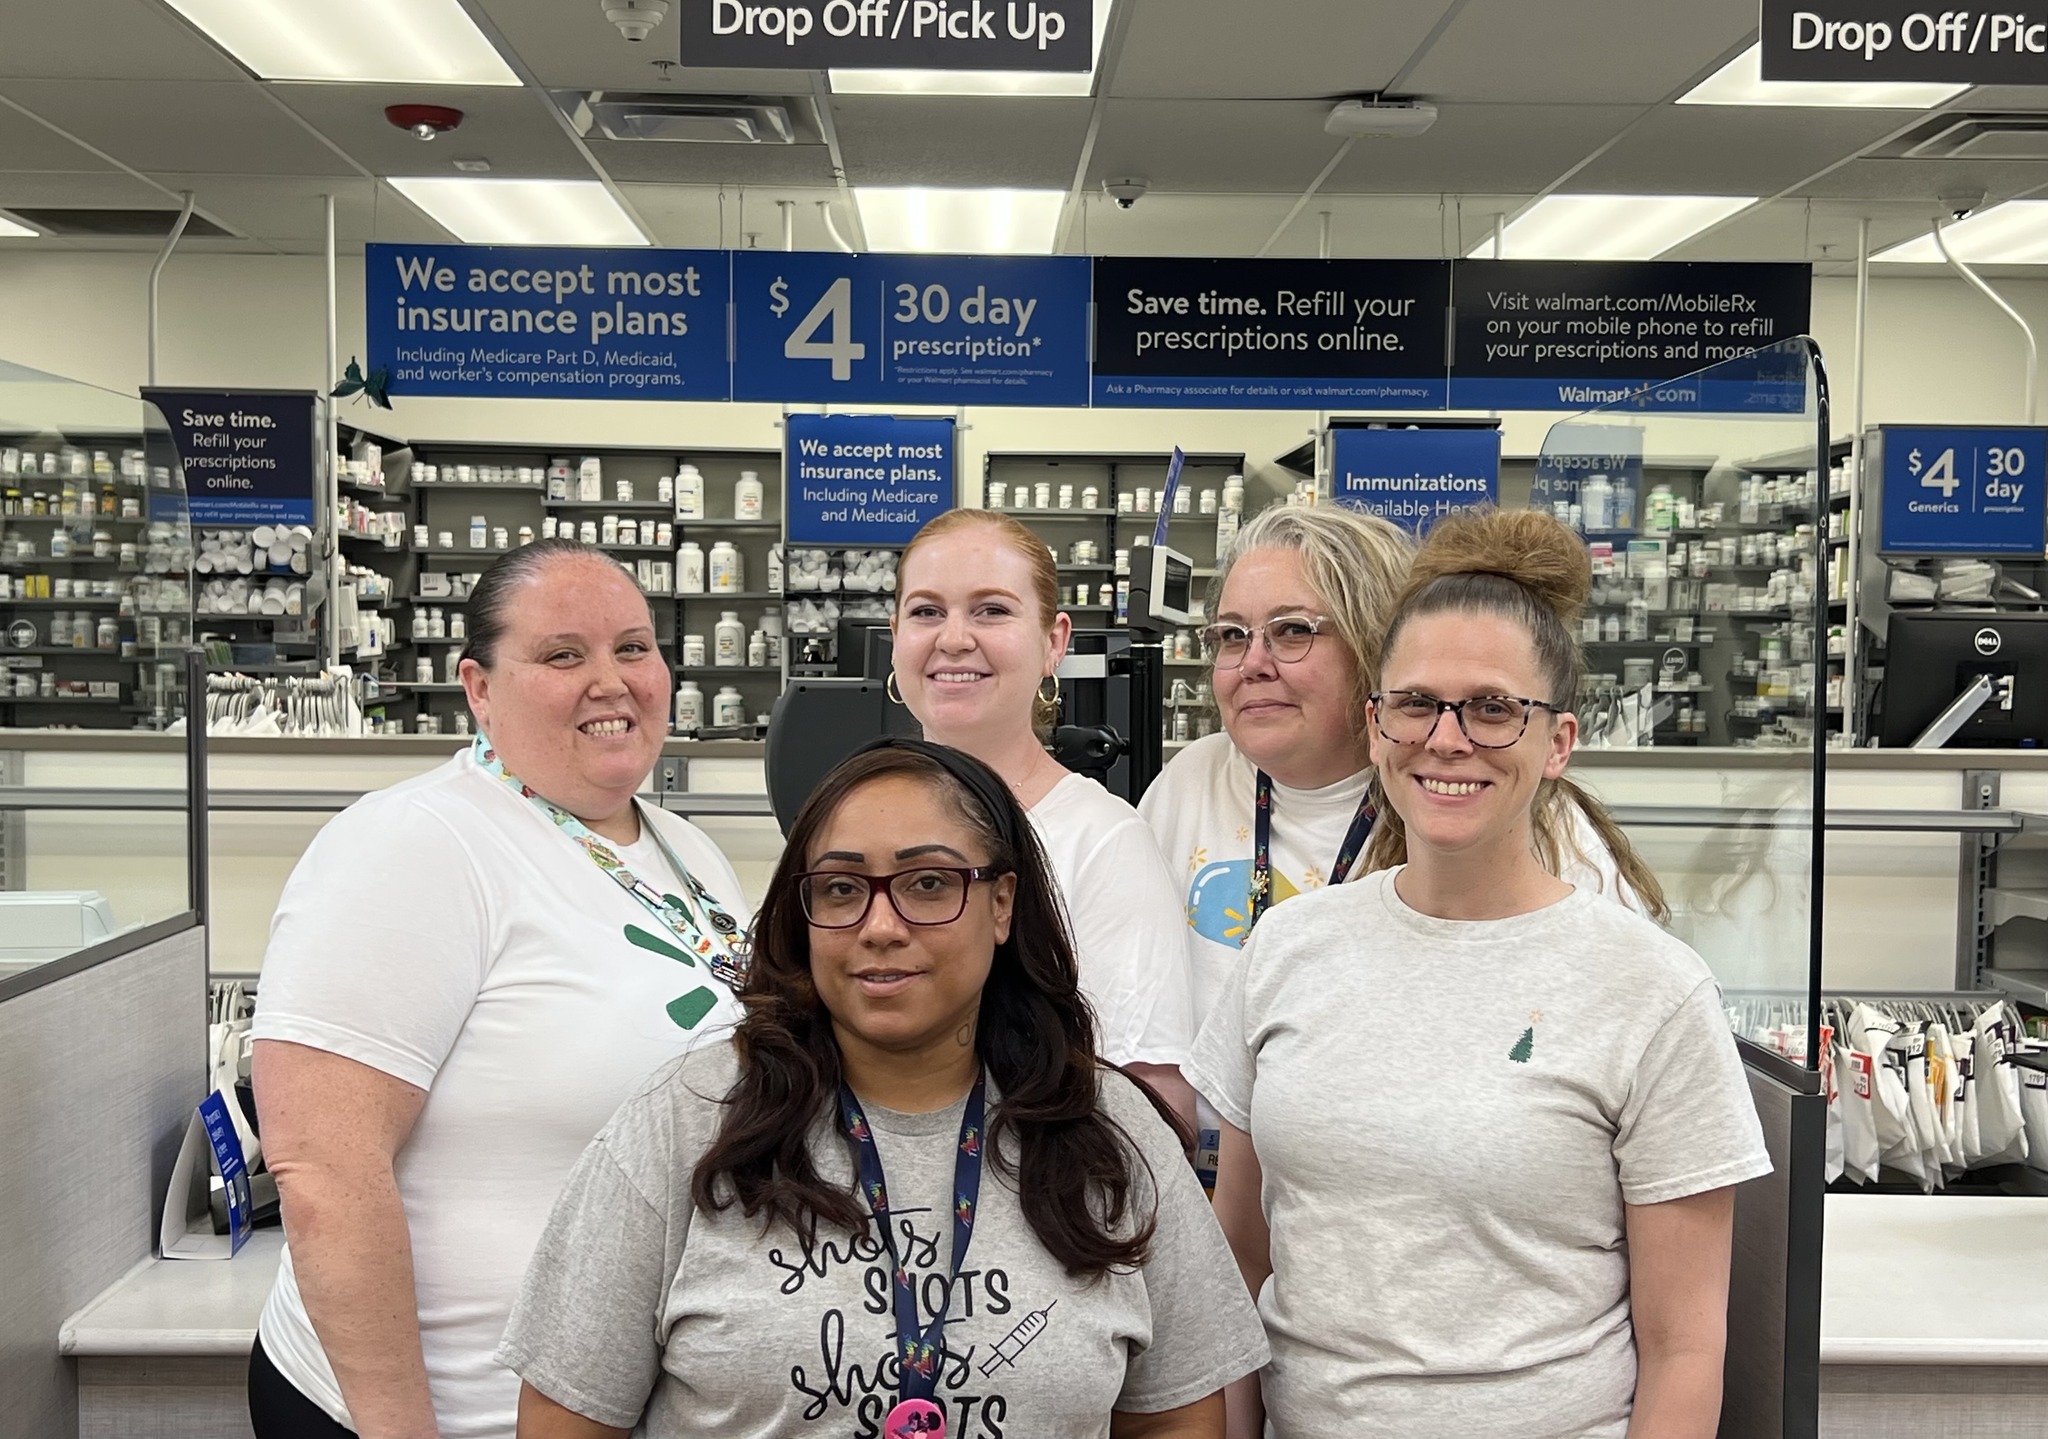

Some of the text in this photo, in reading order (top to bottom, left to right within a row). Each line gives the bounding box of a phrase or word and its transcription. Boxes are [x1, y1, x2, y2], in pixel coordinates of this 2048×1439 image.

[712, 0, 1065, 50] Drop Off/Pick Up
[1792, 11, 2046, 61] Drop Off/Pic
[396, 256, 701, 304] We accept most
[893, 283, 1037, 337] 30 day
[1127, 289, 1416, 324] Save time. Refill your
[1486, 292, 1756, 313] Visit walmart.com/MobileRx
[397, 297, 688, 344] insurance plans
[1486, 316, 1773, 339] on your mobile phone to refill
[1136, 325, 1405, 357] prescriptions online.
[1486, 344, 1529, 362] your
[1535, 340, 1659, 363] prescriptions
[1664, 343, 1699, 359] and
[1705, 345, 1757, 360] more.
[396, 347, 677, 369] Including Medicare Part D, Medicaid,
[396, 367, 685, 388] and worker's compensation programs.
[1106, 384, 1429, 399] Ask a Pharmacy associate for details or visit walmart.com/pharmacy.
[182, 409, 276, 429] Save time.
[193, 432, 267, 451] Refill your
[799, 439, 943, 463] We accept most
[184, 454, 276, 472] prescriptions
[1985, 447, 2025, 476] 30
[206, 475, 254, 490] online.
[800, 462, 942, 485] insurance plans.
[1346, 472, 1487, 491] Immunizations
[803, 487, 938, 506] Including Medicare
[1985, 477, 2024, 503] day
[821, 508, 920, 523] and Medicaid.
[1352, 499, 1429, 517] Available
[1908, 501, 1959, 513] Generics
[769, 1206, 941, 1295] shos
[790, 1308, 975, 1421] shos
[854, 1393, 1007, 1439] STS
